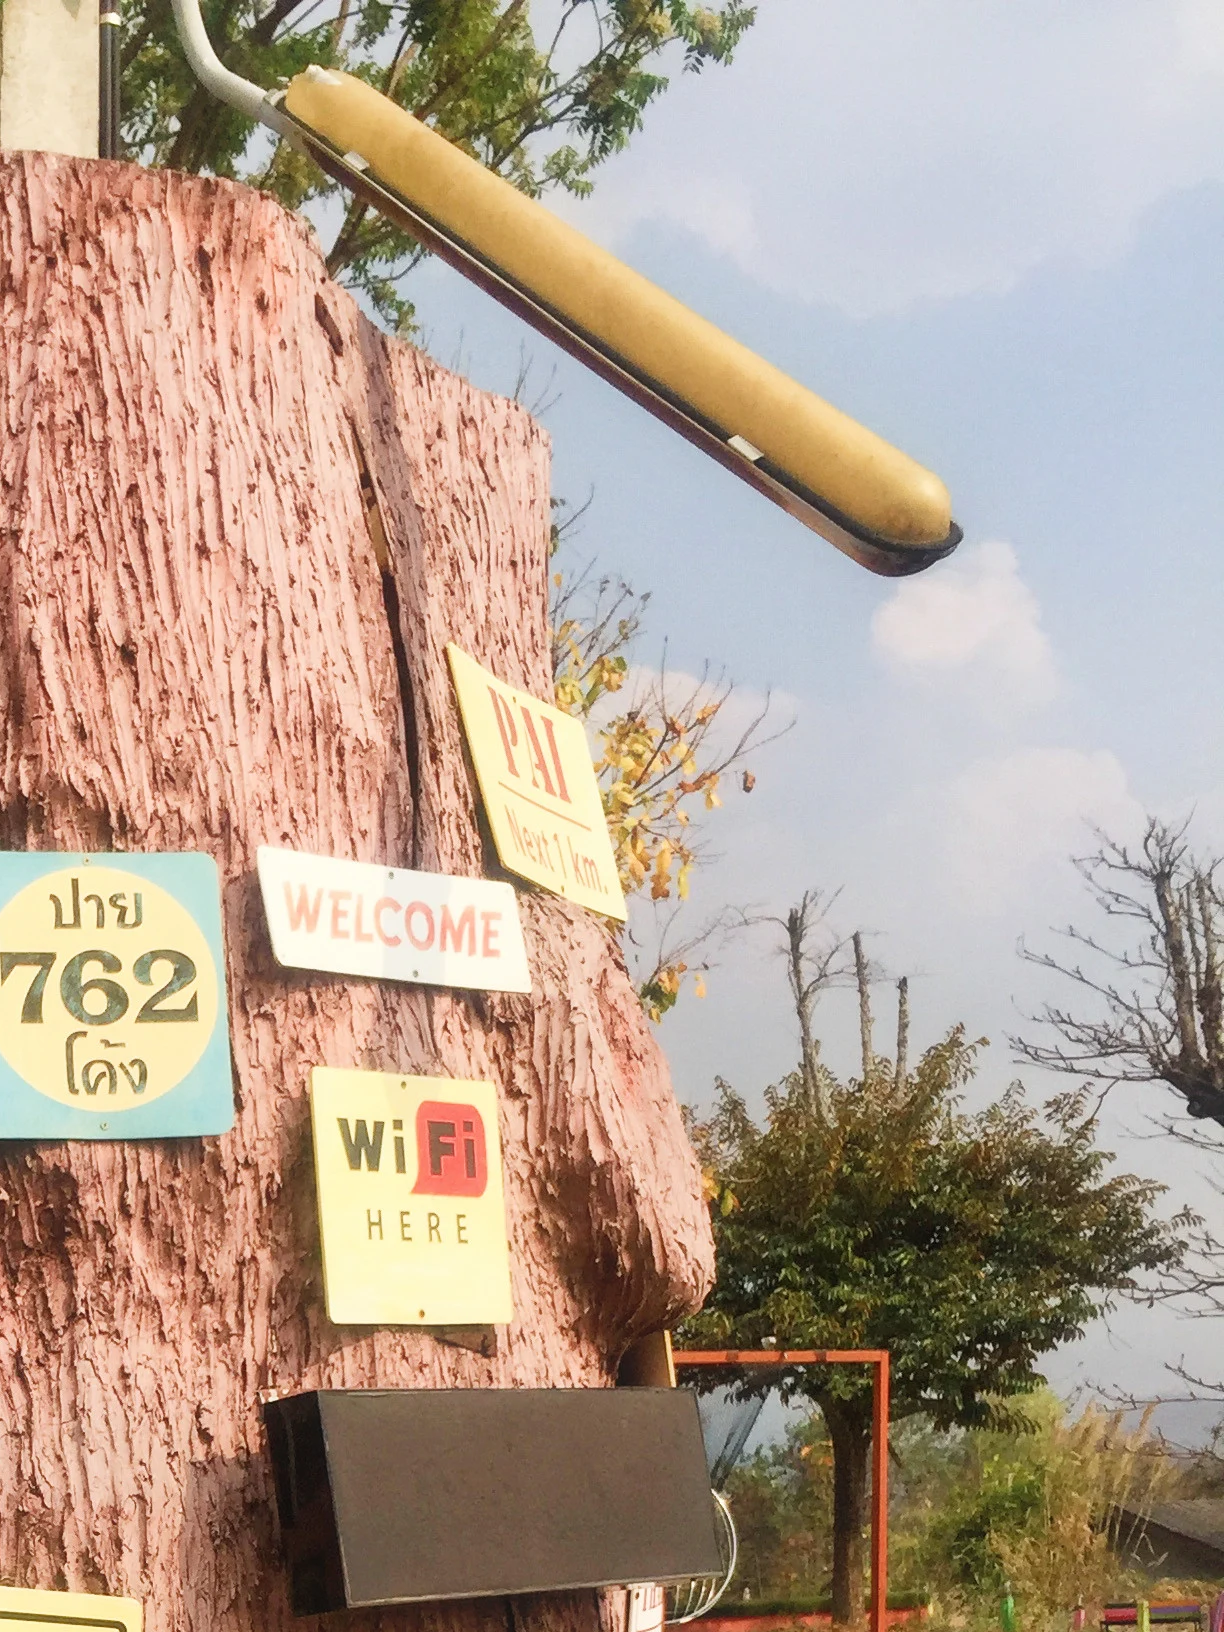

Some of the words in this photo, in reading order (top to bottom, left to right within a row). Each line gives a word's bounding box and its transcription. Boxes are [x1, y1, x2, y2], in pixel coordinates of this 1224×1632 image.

[487, 685, 572, 804] PAI
[504, 804, 555, 873] Next
[567, 834, 609, 894] km.
[49, 878, 143, 930] ปาย
[282, 880, 502, 959] WELCOME
[0, 949, 199, 1026] 762
[65, 1031, 148, 1096] โค้ง
[336, 1117, 478, 1179] WiFi
[366, 1208, 469, 1244] HERE
